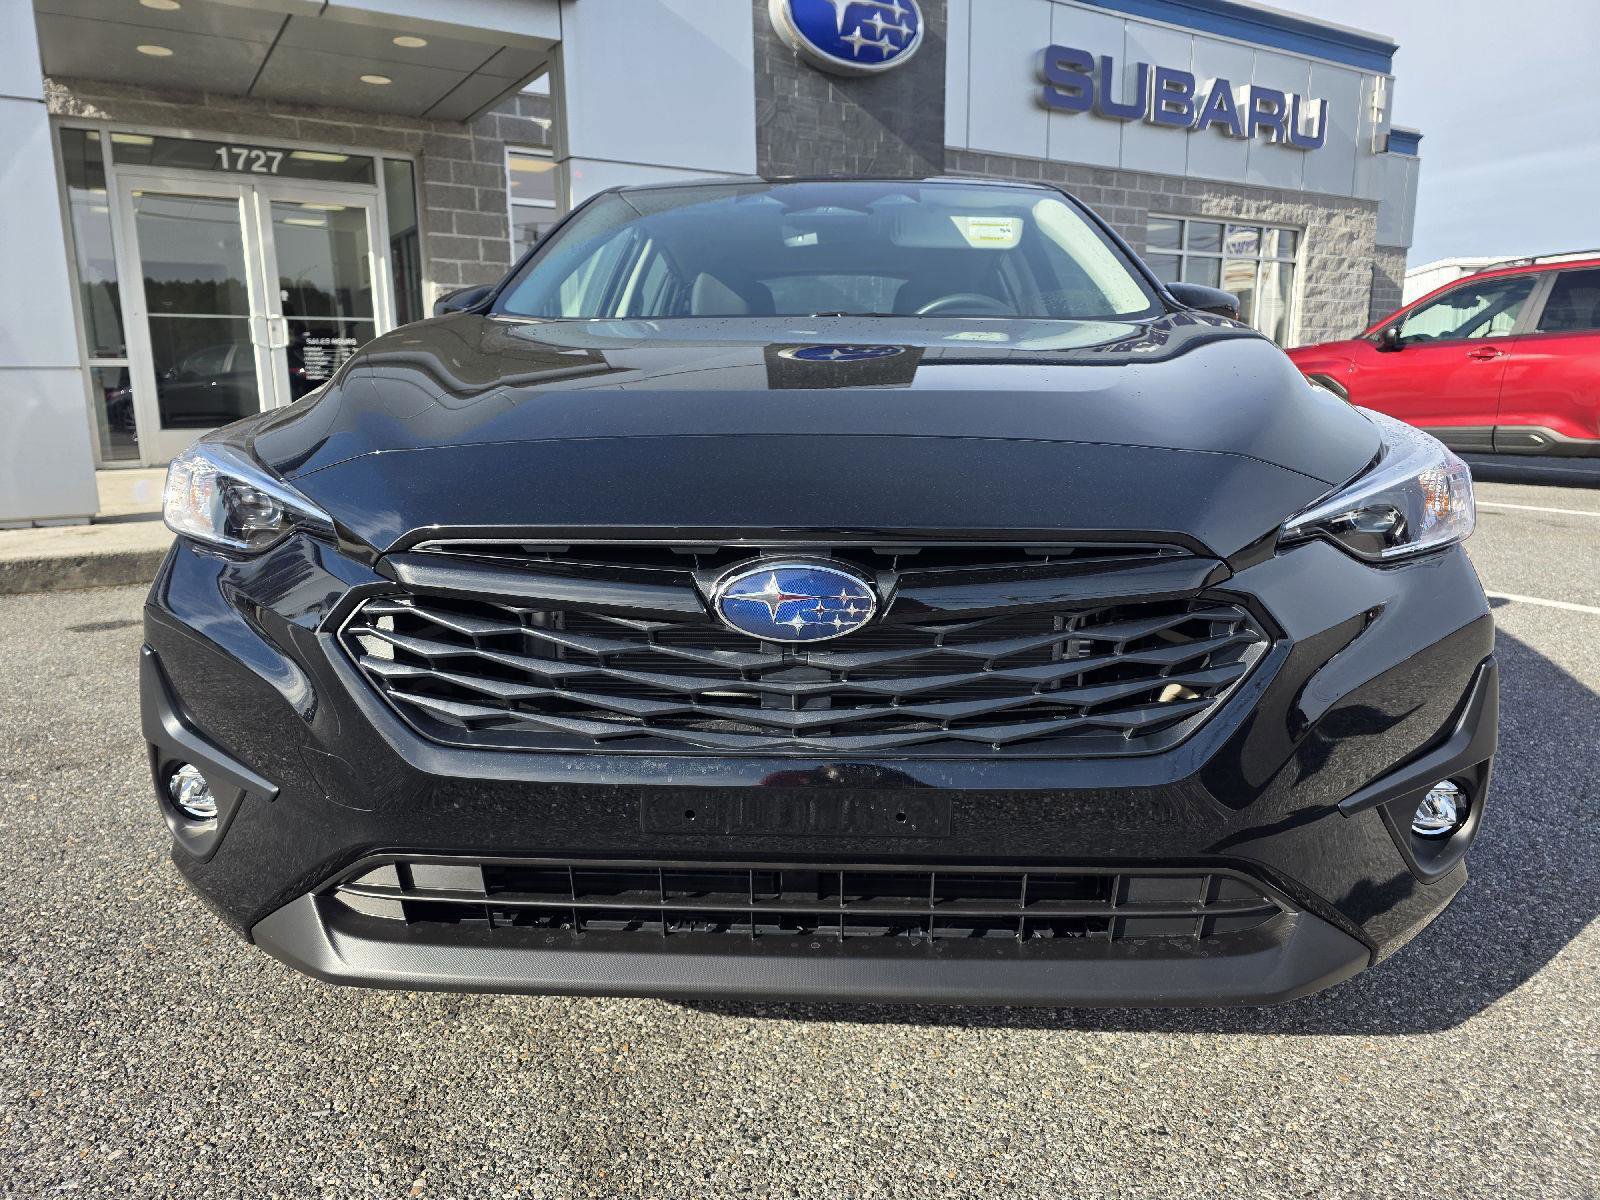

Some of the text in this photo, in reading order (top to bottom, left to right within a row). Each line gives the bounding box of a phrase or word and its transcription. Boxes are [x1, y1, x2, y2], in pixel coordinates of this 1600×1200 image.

[1042, 44, 1329, 150] SUBARU
[215, 146, 283, 174] 1727
[305, 337, 357, 346] SALES HOURS
